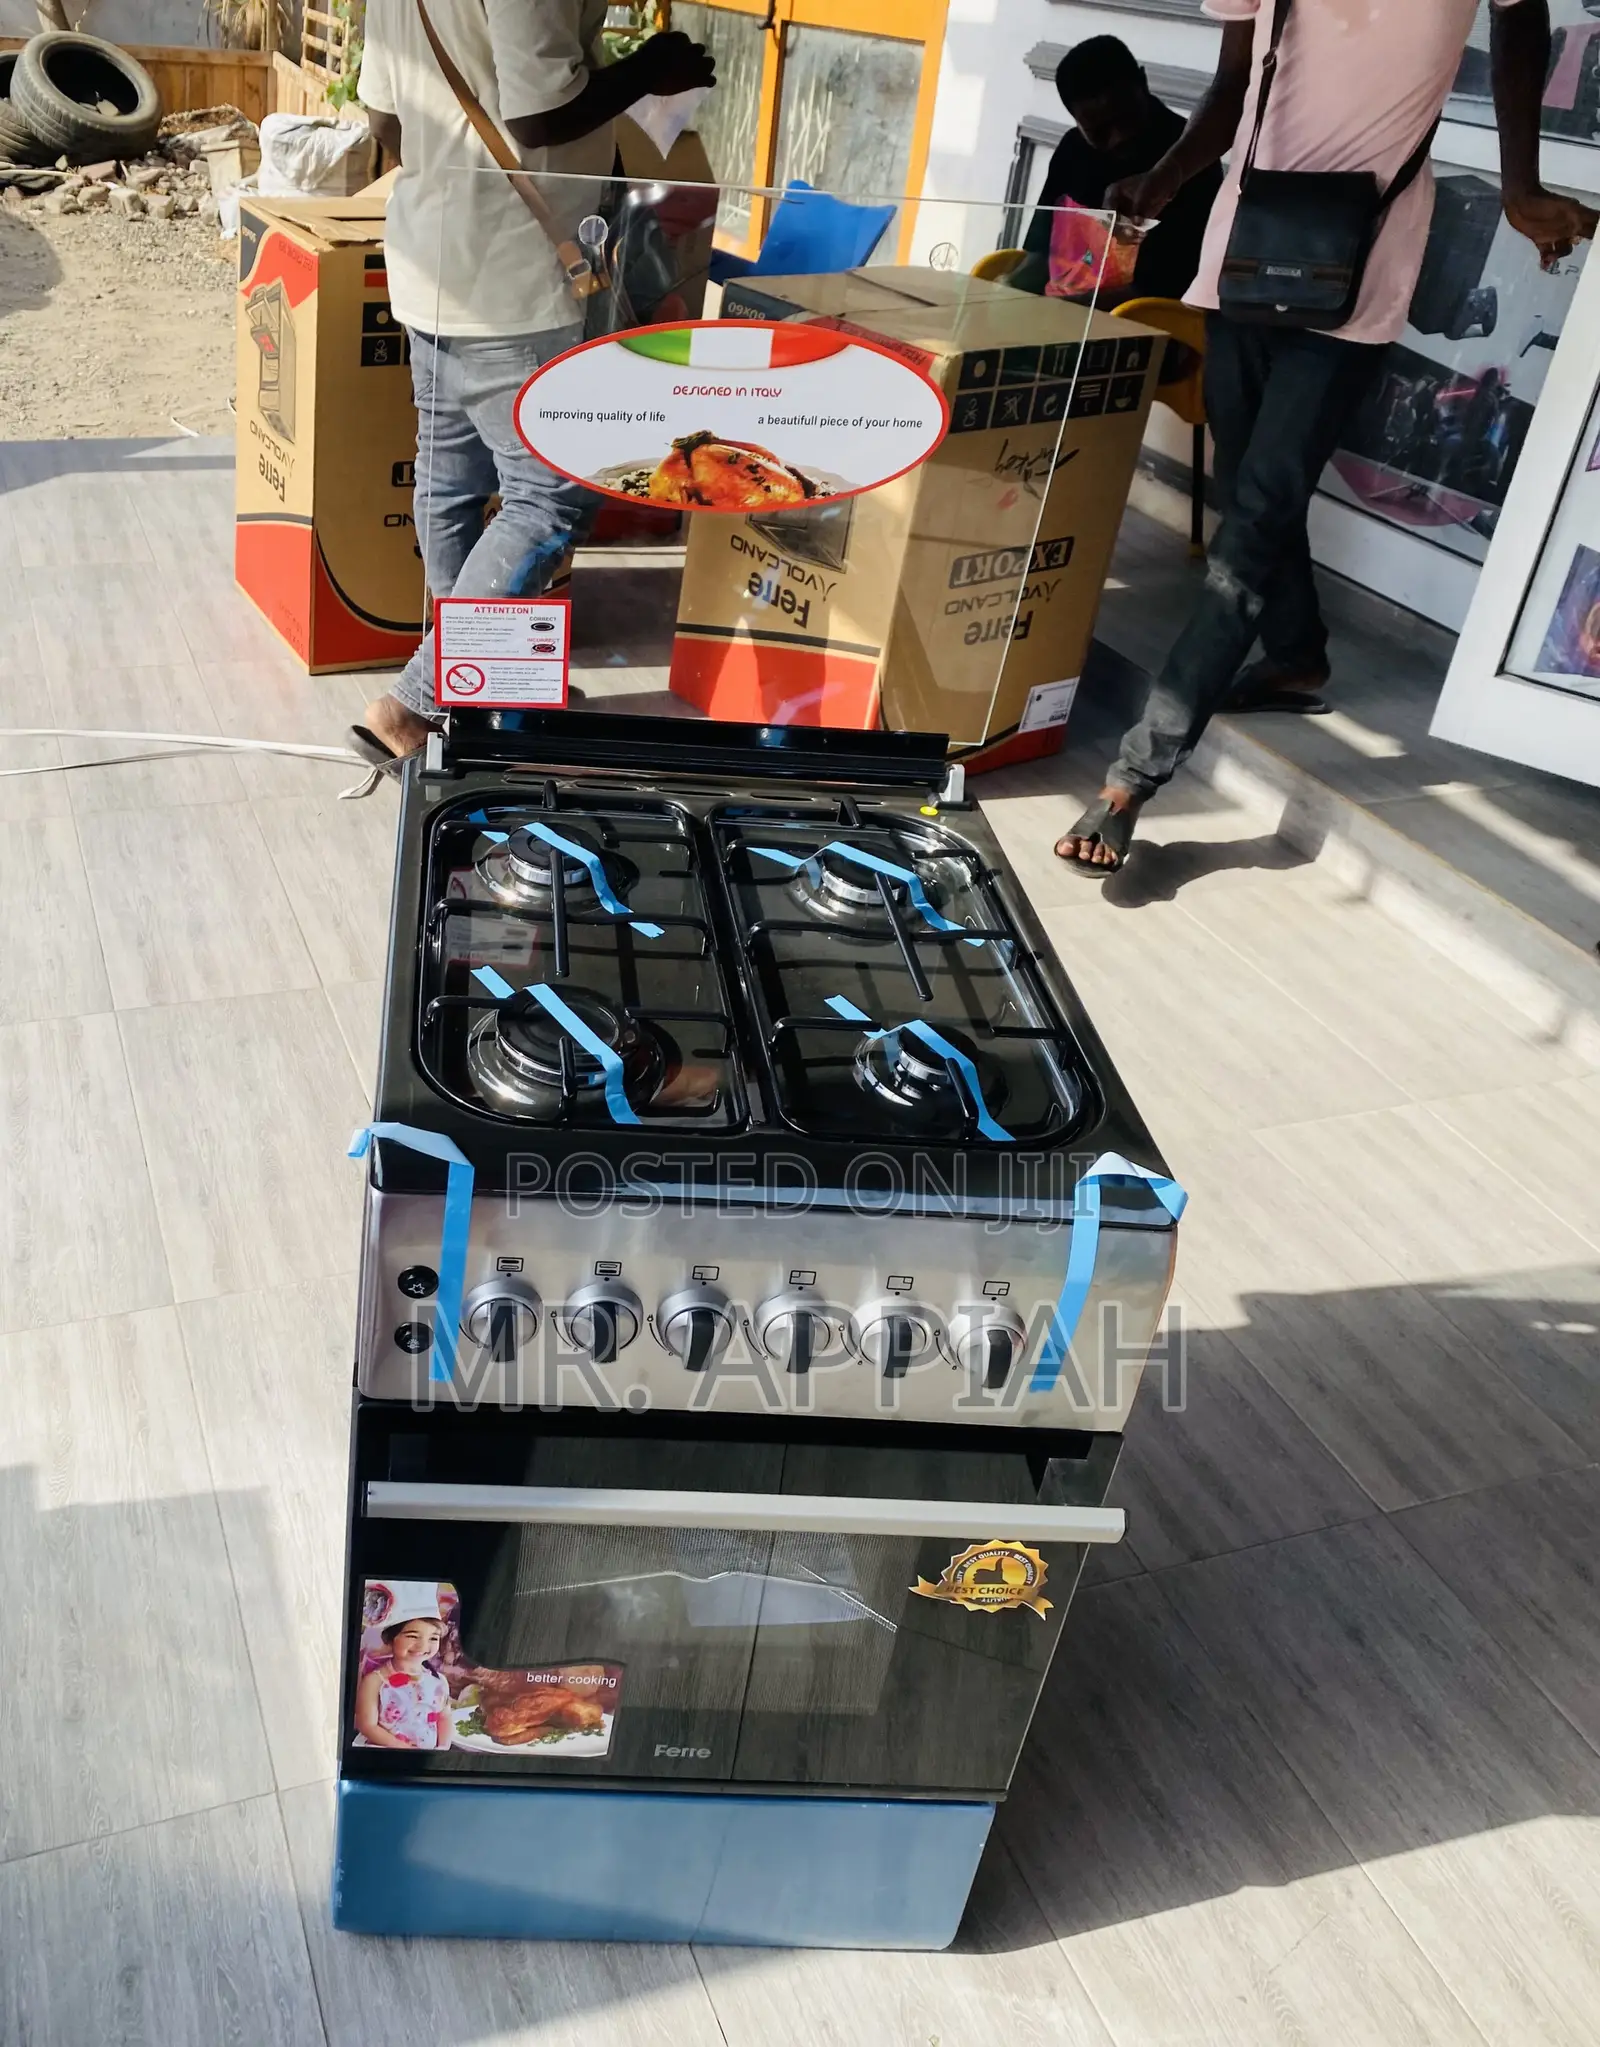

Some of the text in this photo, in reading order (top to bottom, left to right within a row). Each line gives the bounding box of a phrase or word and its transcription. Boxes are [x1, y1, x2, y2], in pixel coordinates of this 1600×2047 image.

[673, 385, 783, 398] DESIGNED IN ITALY
[539, 408, 666, 423] improving quality of life
[758, 415, 923, 429] a beautifull piece of your home
[259, 452, 285, 503] Ferre
[730, 534, 818, 590] VOLCANO
[953, 540, 1069, 586] EXPORT
[748, 572, 811, 629] Ferre
[945, 583, 1042, 616] VOLCANO
[964, 611, 1034, 645] Ferre
[978, 1550, 1010, 1559] QUALITY
[946, 1586, 1025, 1595] BEST CHOICE
[526, 1672, 617, 1688] better cooking
[654, 1743, 712, 1759] Ferre
